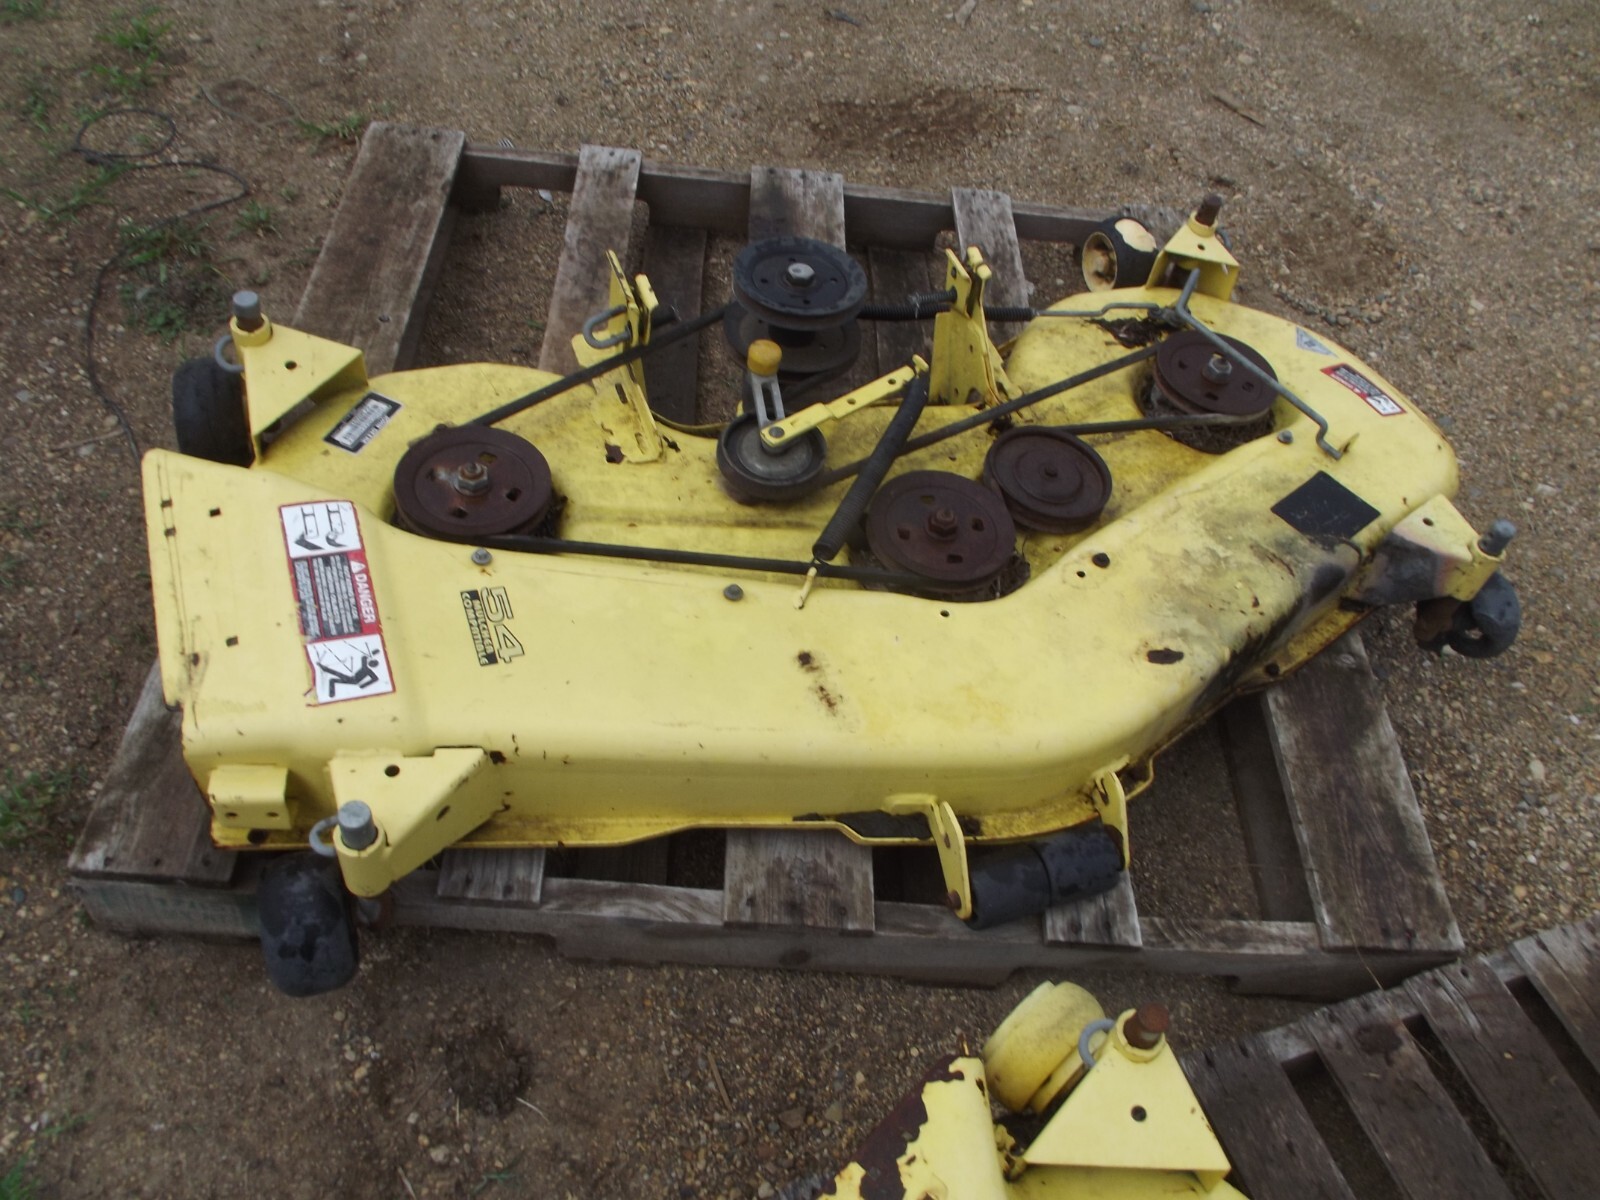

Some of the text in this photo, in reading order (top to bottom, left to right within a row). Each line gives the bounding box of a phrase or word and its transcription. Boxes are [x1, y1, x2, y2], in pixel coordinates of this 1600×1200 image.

[354, 573, 376, 624] DANGER
[461, 591, 489, 665] COMPATIBLE
[472, 599, 495, 654] MULCHER
[481, 586, 525, 664] 54
